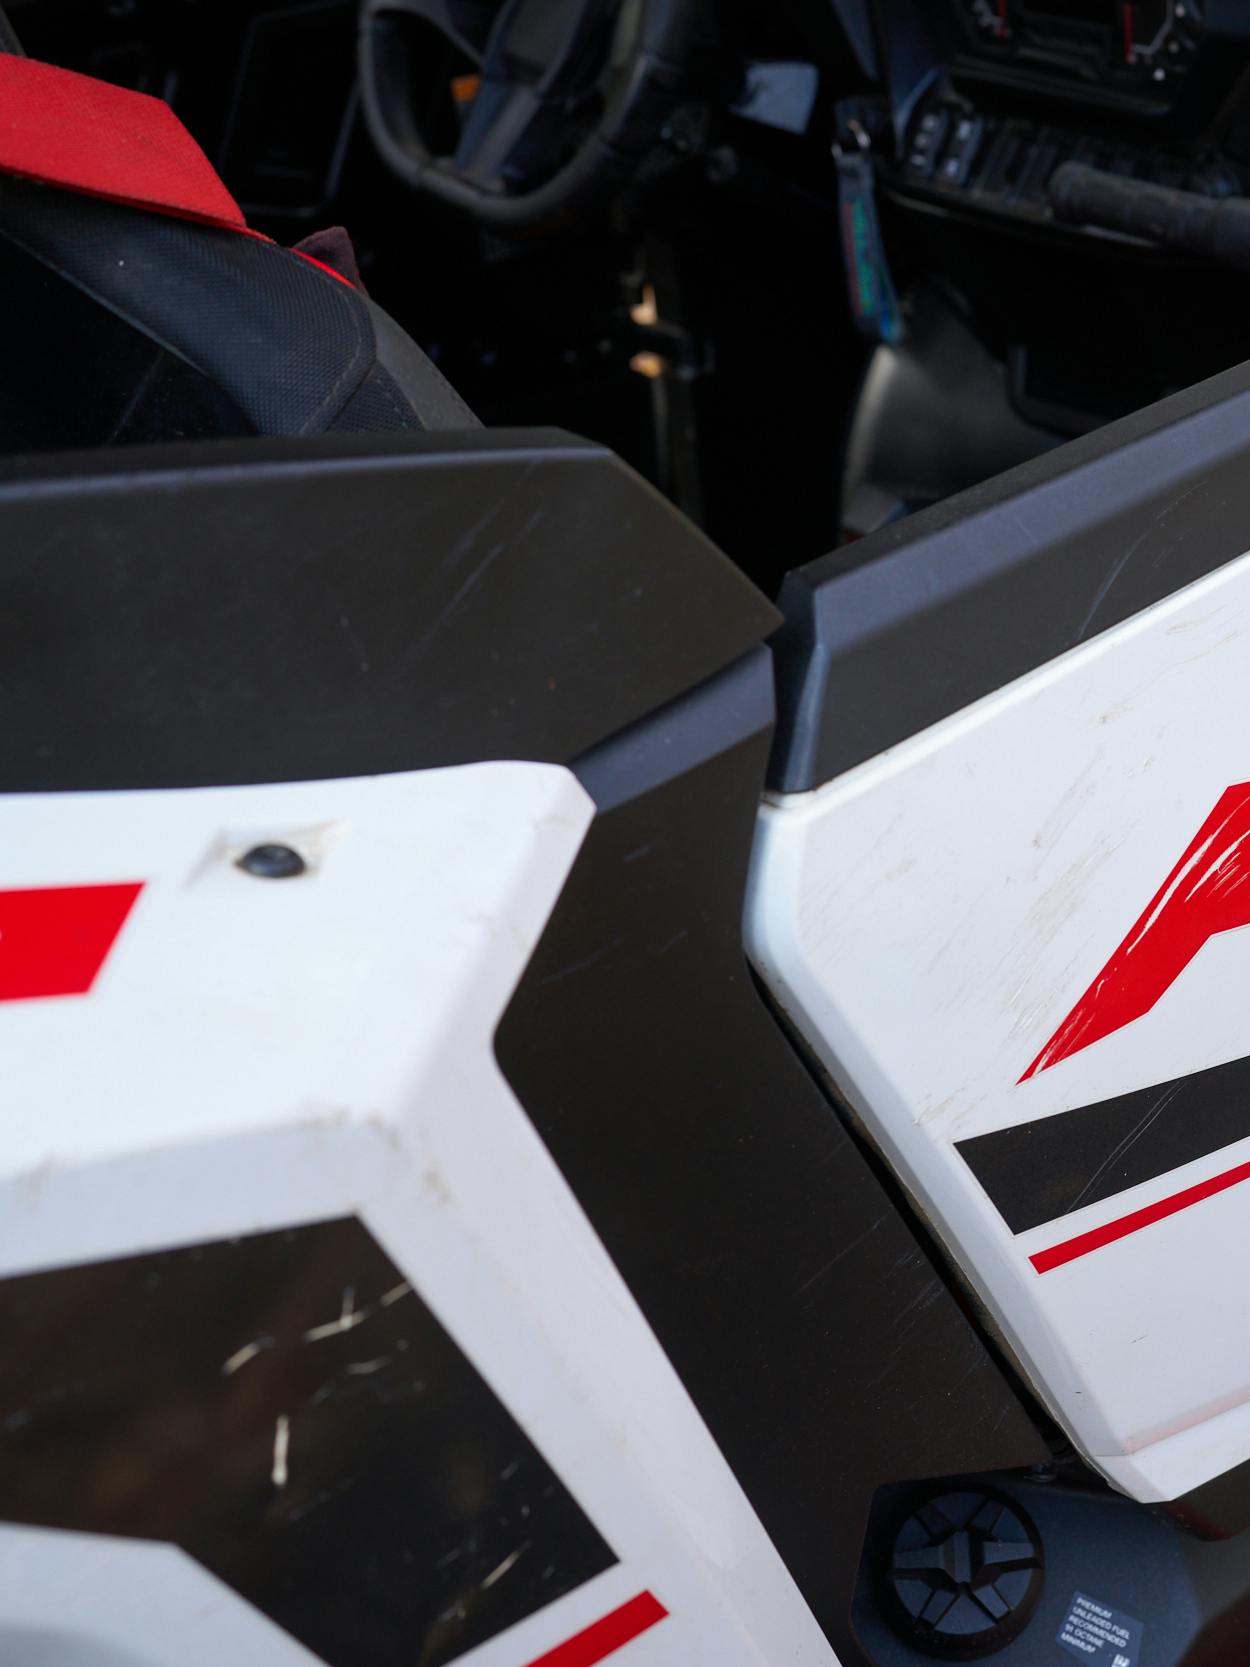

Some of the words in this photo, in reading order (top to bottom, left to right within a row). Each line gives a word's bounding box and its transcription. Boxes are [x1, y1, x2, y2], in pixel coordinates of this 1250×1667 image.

[1076, 1597, 1112, 1618] PREMIUM
[1068, 1615, 1126, 1647] RECOMMENDED
[1072, 1606, 1112, 1629] UNLEADED
[1112, 1625, 1130, 1640] FUEL
[1060, 1632, 1096, 1653] MINIMUM
[1074, 1627, 1105, 1648] OCTANE
